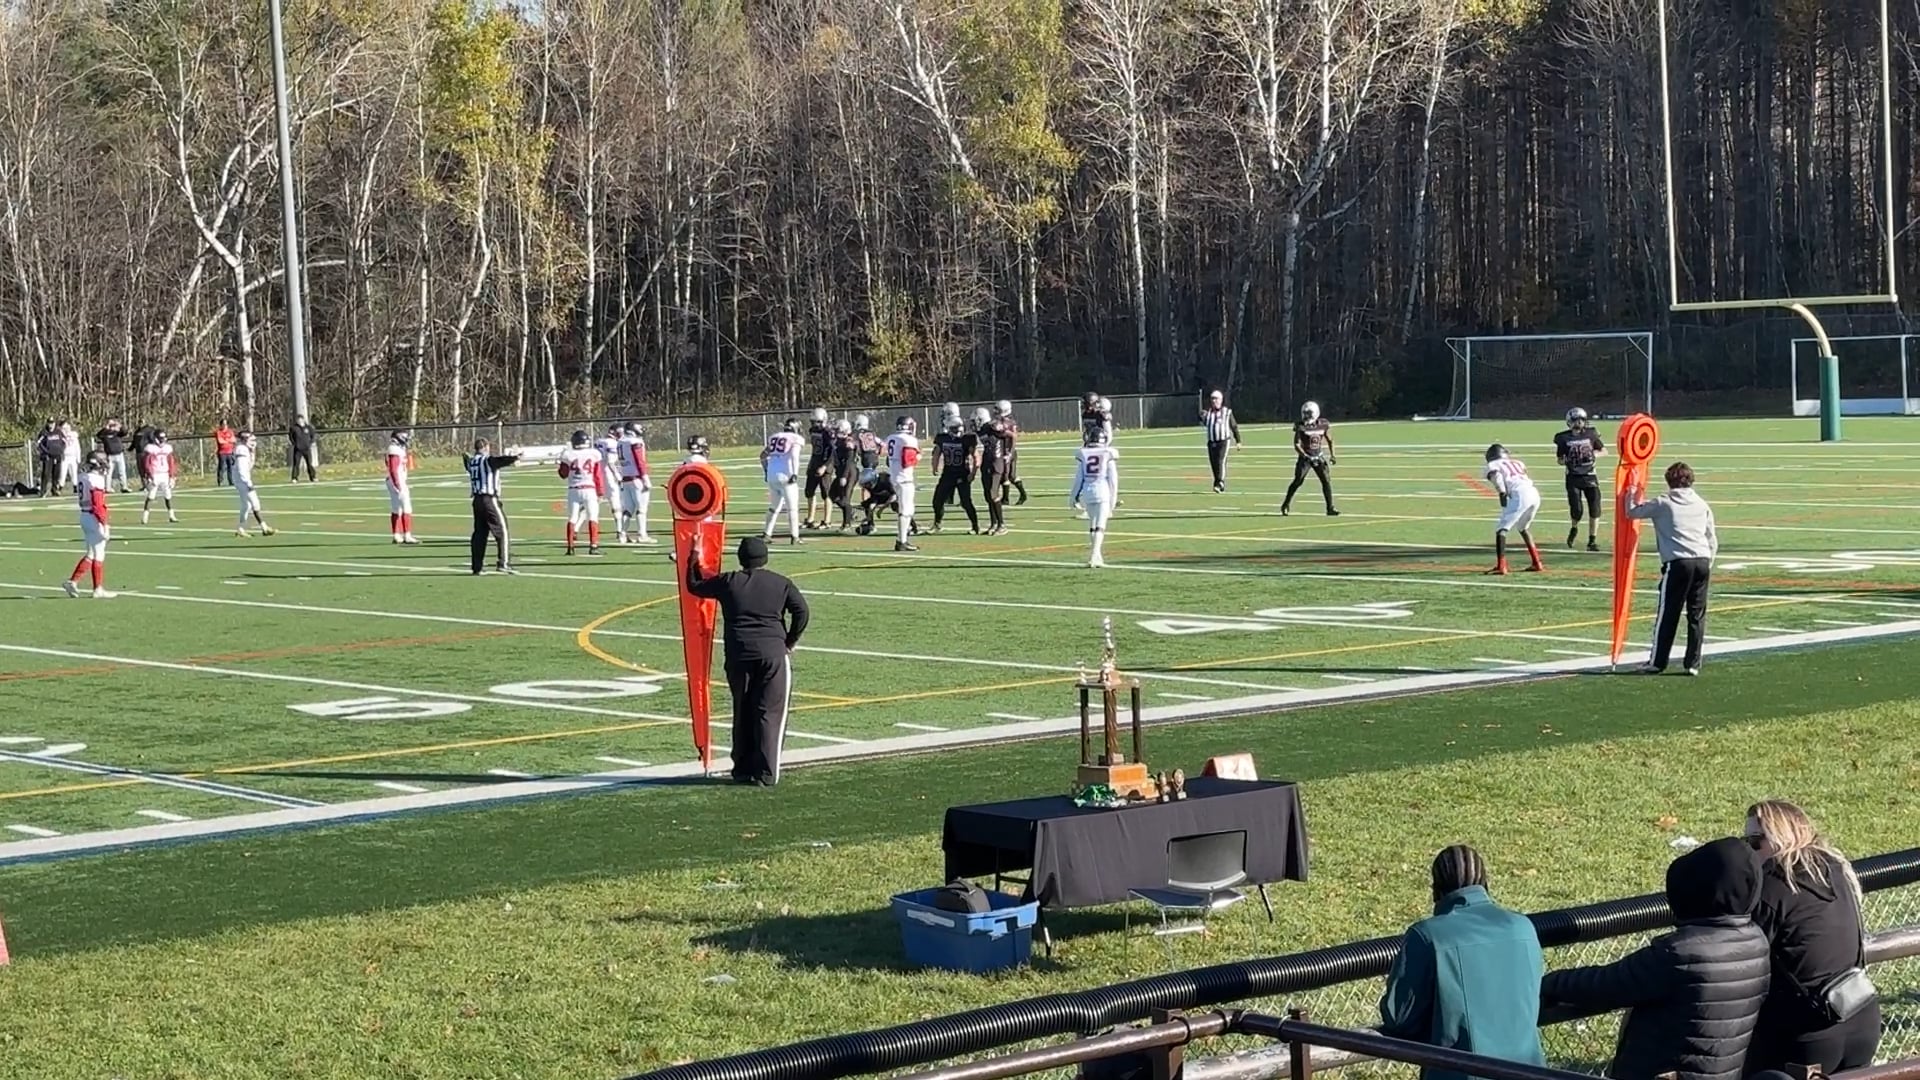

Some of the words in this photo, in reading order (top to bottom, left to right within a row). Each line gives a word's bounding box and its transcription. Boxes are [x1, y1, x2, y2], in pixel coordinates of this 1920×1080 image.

[888, 439, 896, 457] 6
[570, 458, 592, 475] 44
[1087, 455, 1100, 474] 2
[1135, 606, 1415, 635] 40
[286, 680, 663, 721] 50
